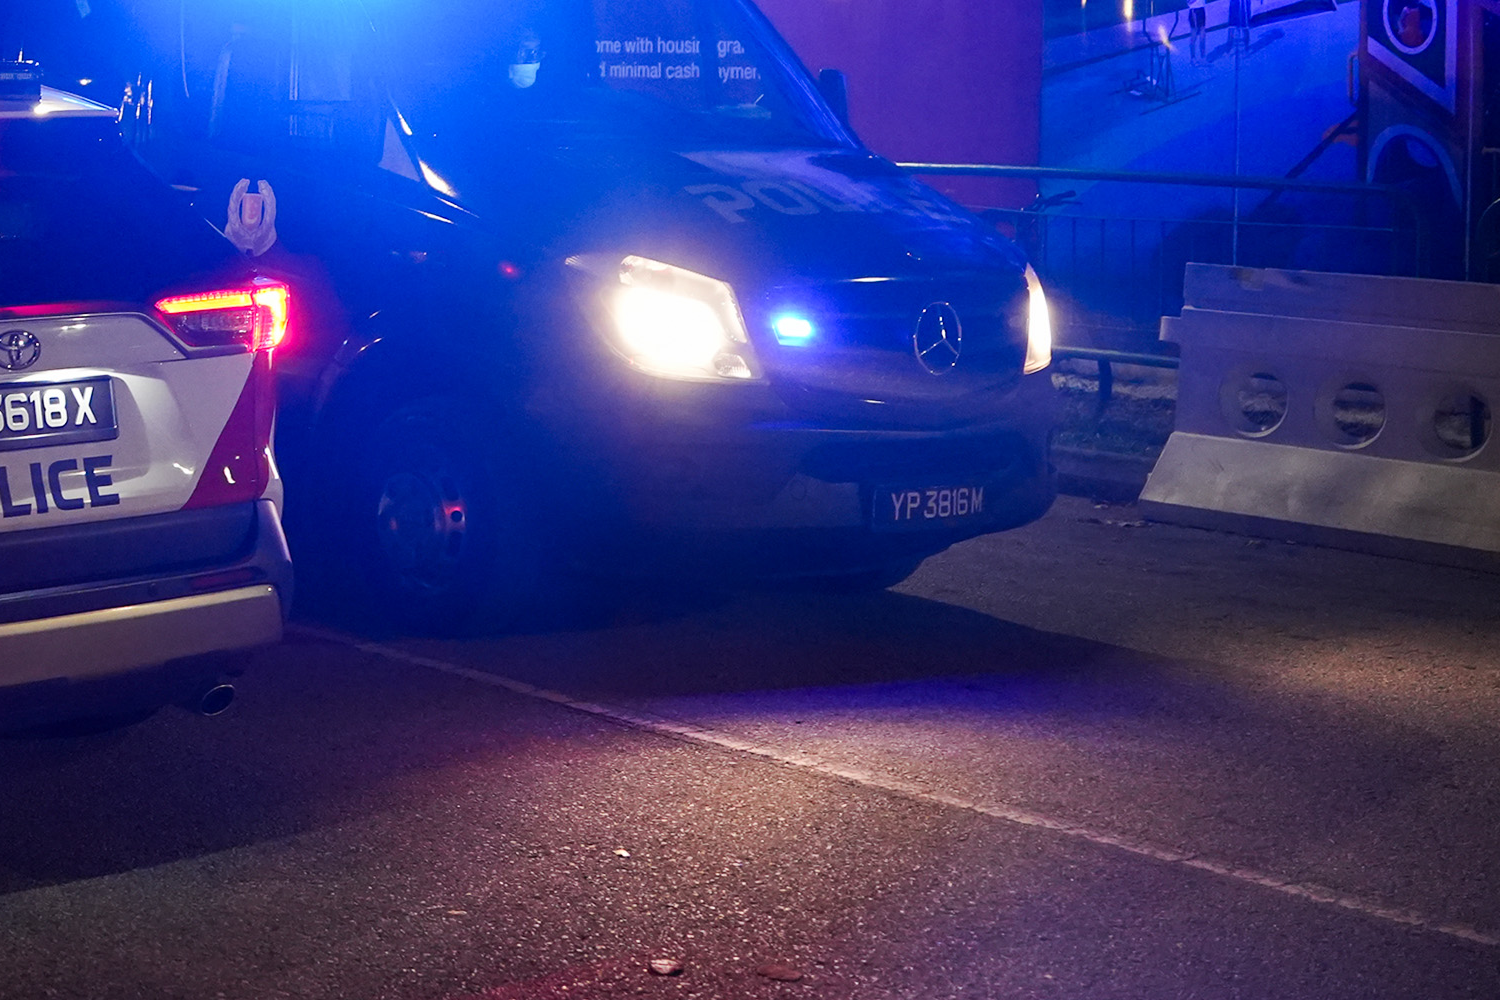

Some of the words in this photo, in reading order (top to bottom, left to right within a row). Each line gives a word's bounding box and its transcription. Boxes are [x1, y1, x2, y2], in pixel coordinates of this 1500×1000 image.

[624, 36, 654, 54] with
[609, 60, 662, 79] minimal
[665, 61, 700, 79] cash
